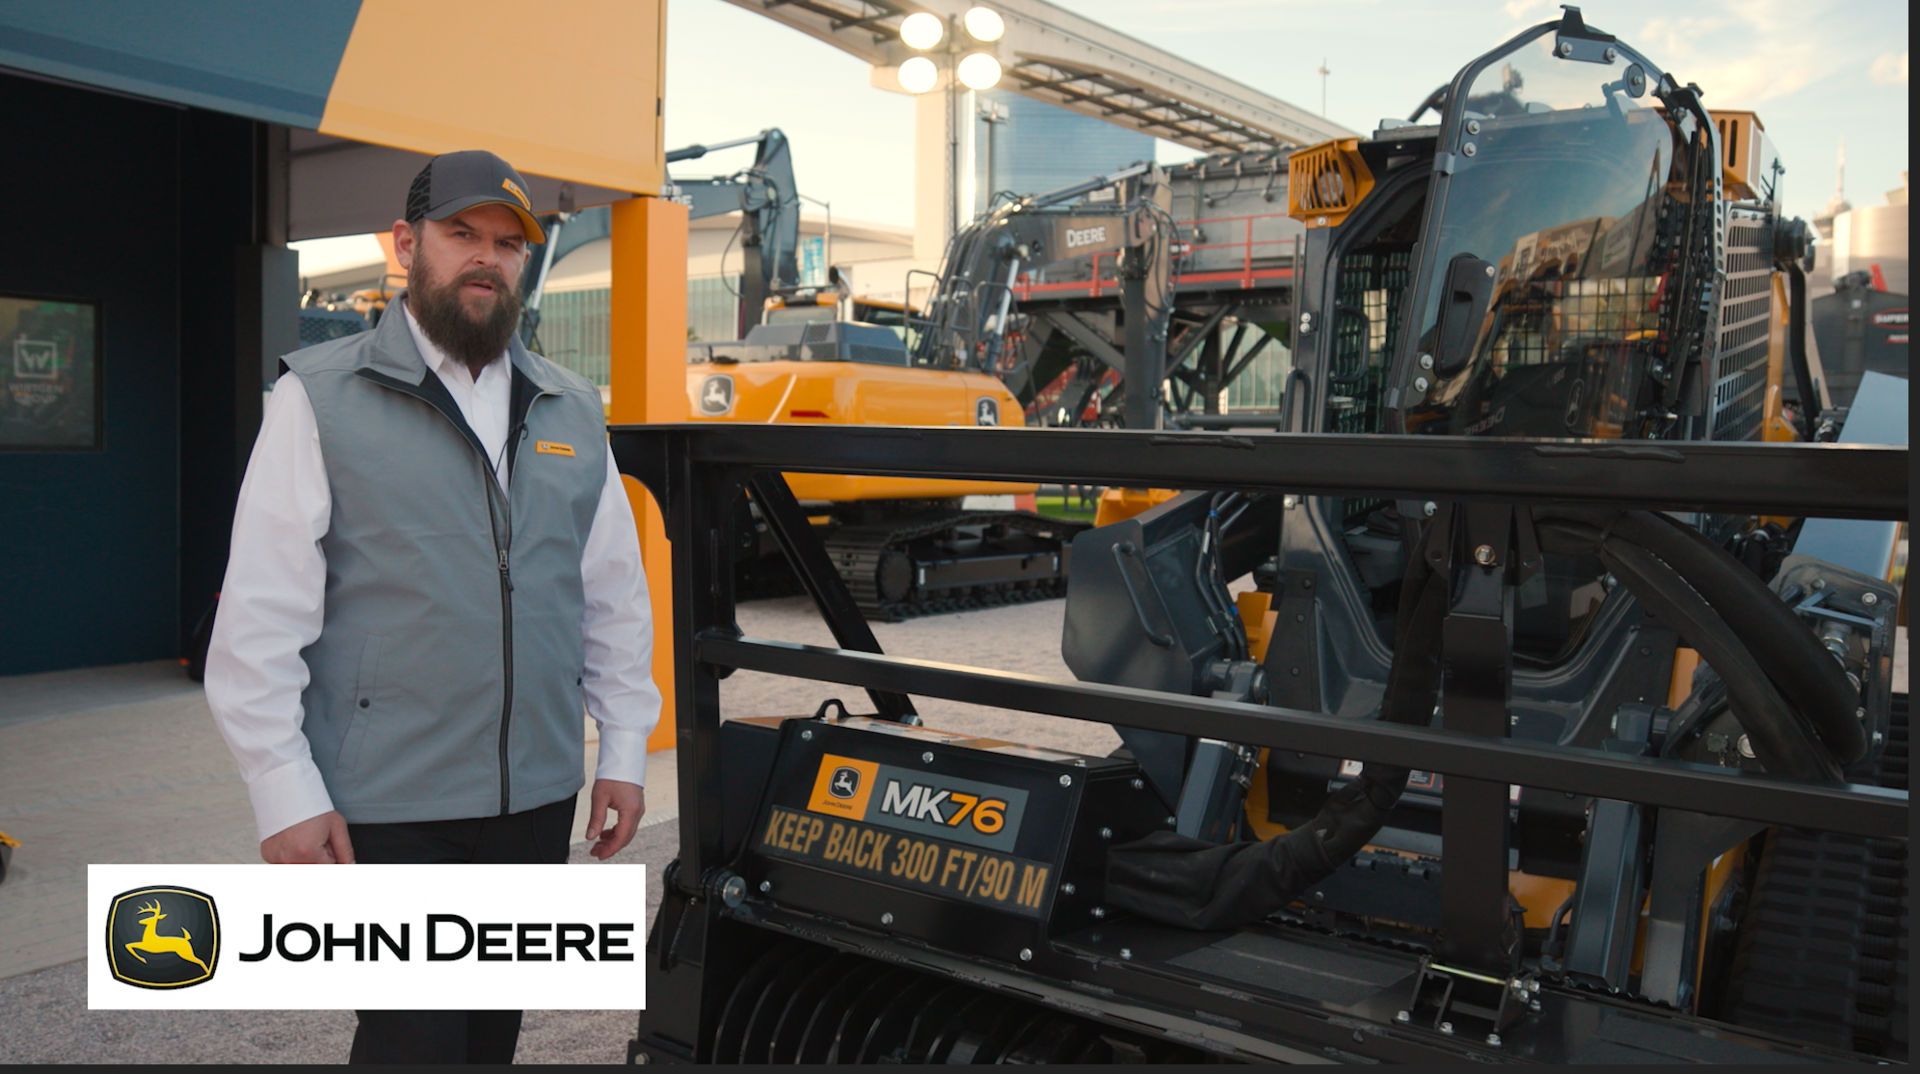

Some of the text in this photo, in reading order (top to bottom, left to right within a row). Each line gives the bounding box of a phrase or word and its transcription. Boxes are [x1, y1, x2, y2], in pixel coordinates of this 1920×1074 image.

[1066, 226, 1106, 248] DEERE
[881, 780, 1006, 834] MK76
[764, 810, 1048, 908] KEEP BACK 300 FT/90 M
